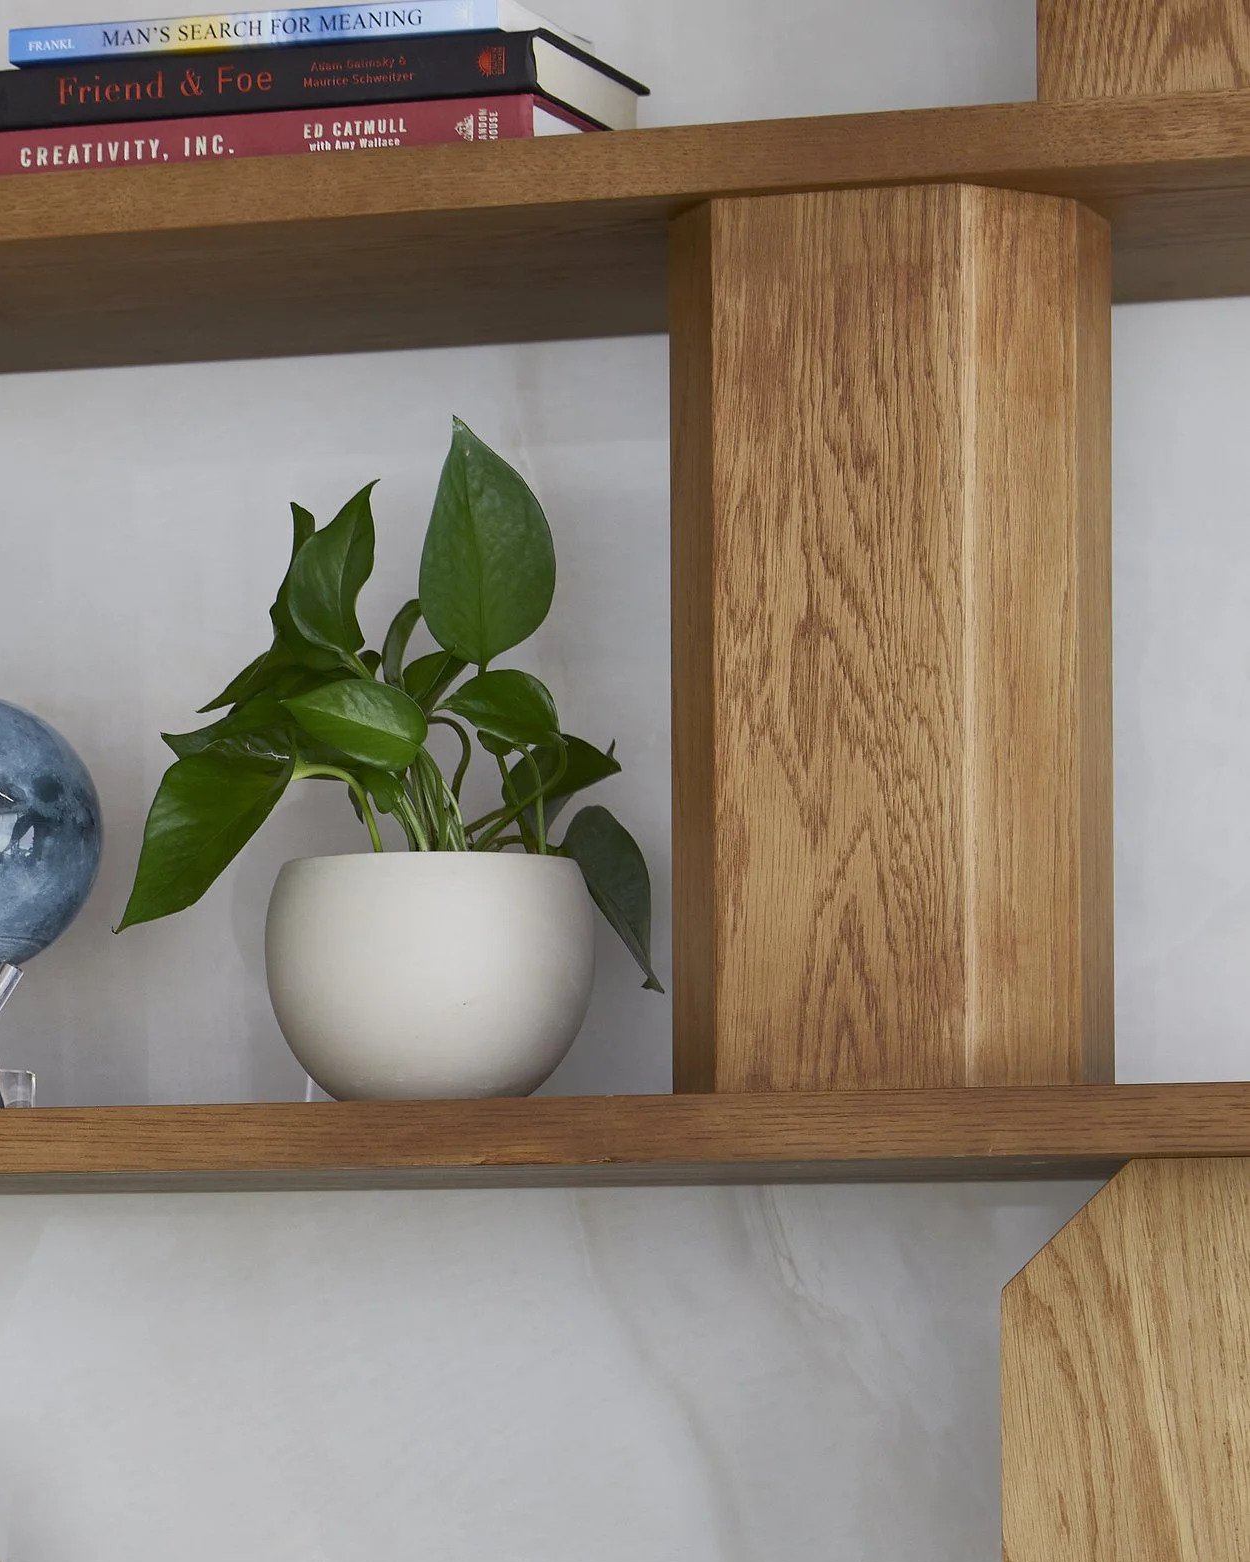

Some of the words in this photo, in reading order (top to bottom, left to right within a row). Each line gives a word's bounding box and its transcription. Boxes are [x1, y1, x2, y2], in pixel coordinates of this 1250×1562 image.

[102, 26, 171, 47] MAN'S
[178, 20, 261, 41] SEARCH
[271, 16, 311, 35] FOR
[319, 9, 423, 32] MEANING
[28, 38, 75, 52] FRANKL
[310, 61, 343, 72] Adam
[346, 56, 395, 69] Galinsky
[398, 55, 407, 66] &
[58, 70, 165, 106] Friend
[180, 68, 203, 97] &
[217, 64, 274, 94] Foe
[303, 76, 349, 88] Maurice
[352, 72, 414, 85] Schweitzer
[303, 123, 323, 139] ED
[332, 117, 407, 137] CATMULL
[20, 138, 169, 168] CREATIVITY,
[184, 134, 235, 157] INC.
[309, 141, 331, 152] with
[335, 140, 355, 151] Amy
[359, 137, 400, 149] Wallace
